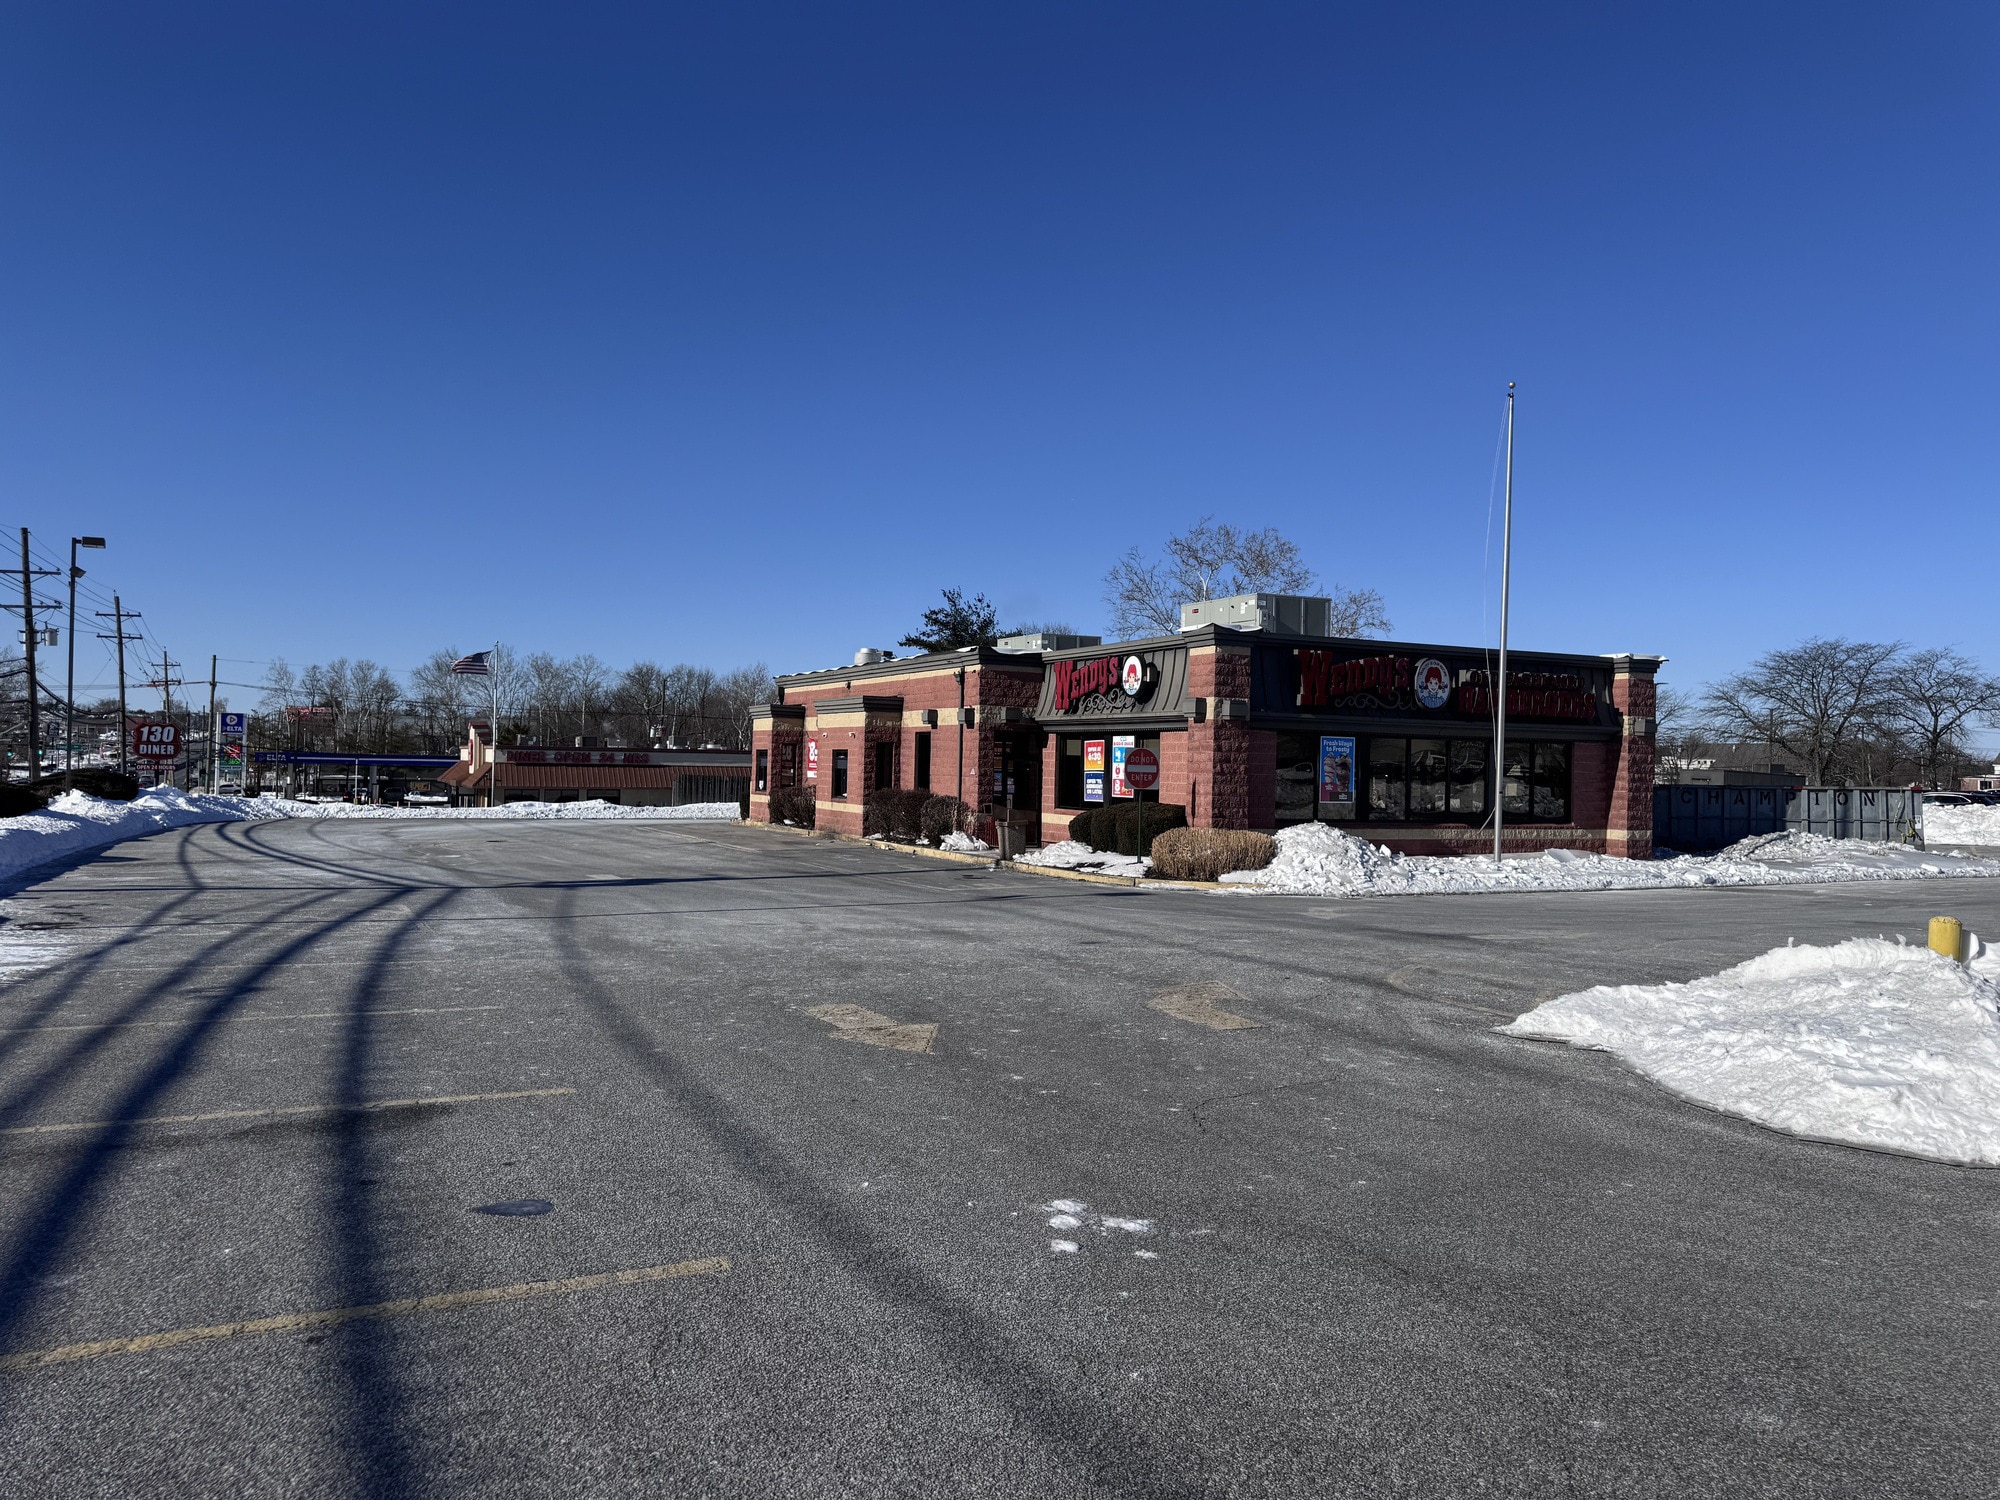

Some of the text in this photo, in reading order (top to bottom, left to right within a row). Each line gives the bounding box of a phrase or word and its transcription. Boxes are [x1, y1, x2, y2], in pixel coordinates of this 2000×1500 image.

[140, 726, 175, 742] 130
[139, 744, 175, 755] DINER
[506, 752, 649, 763] DINER OPEN 24 HRS
[1131, 773, 1153, 781] ENTER
[1680, 790, 1875, 805] CHAMPION
